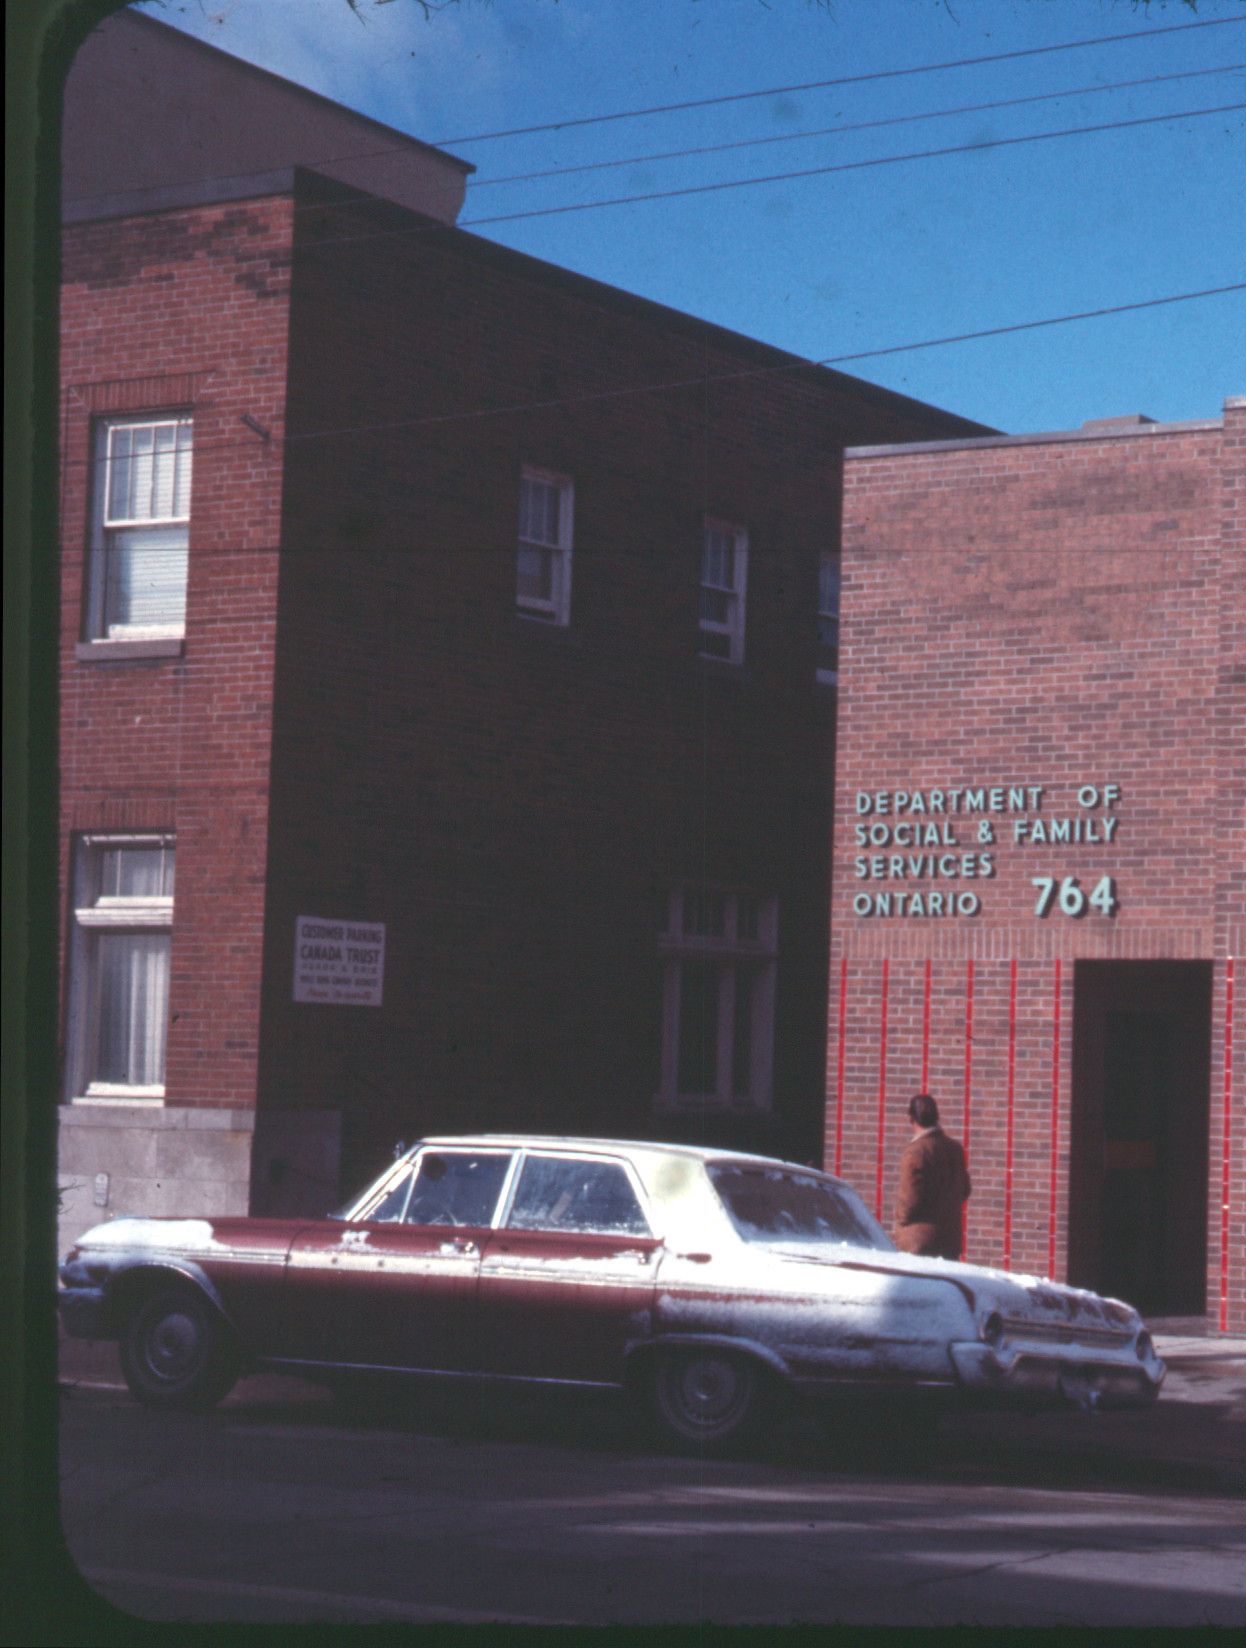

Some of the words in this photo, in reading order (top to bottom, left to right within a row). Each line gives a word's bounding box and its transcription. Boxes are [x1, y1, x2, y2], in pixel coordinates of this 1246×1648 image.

[856, 786, 1043, 814] DEPARTMENT
[1077, 784, 1120, 809] OF
[855, 821, 957, 846] SOCIAL
[976, 819, 993, 844] &
[1013, 816, 1117, 844] FAMILY
[855, 852, 993, 877] SERVICES
[853, 891, 978, 916] ONTARIO
[1031, 875, 1115, 916] 764
[301, 944, 342, 961] CANADA
[346, 947, 381, 964] TRUST
